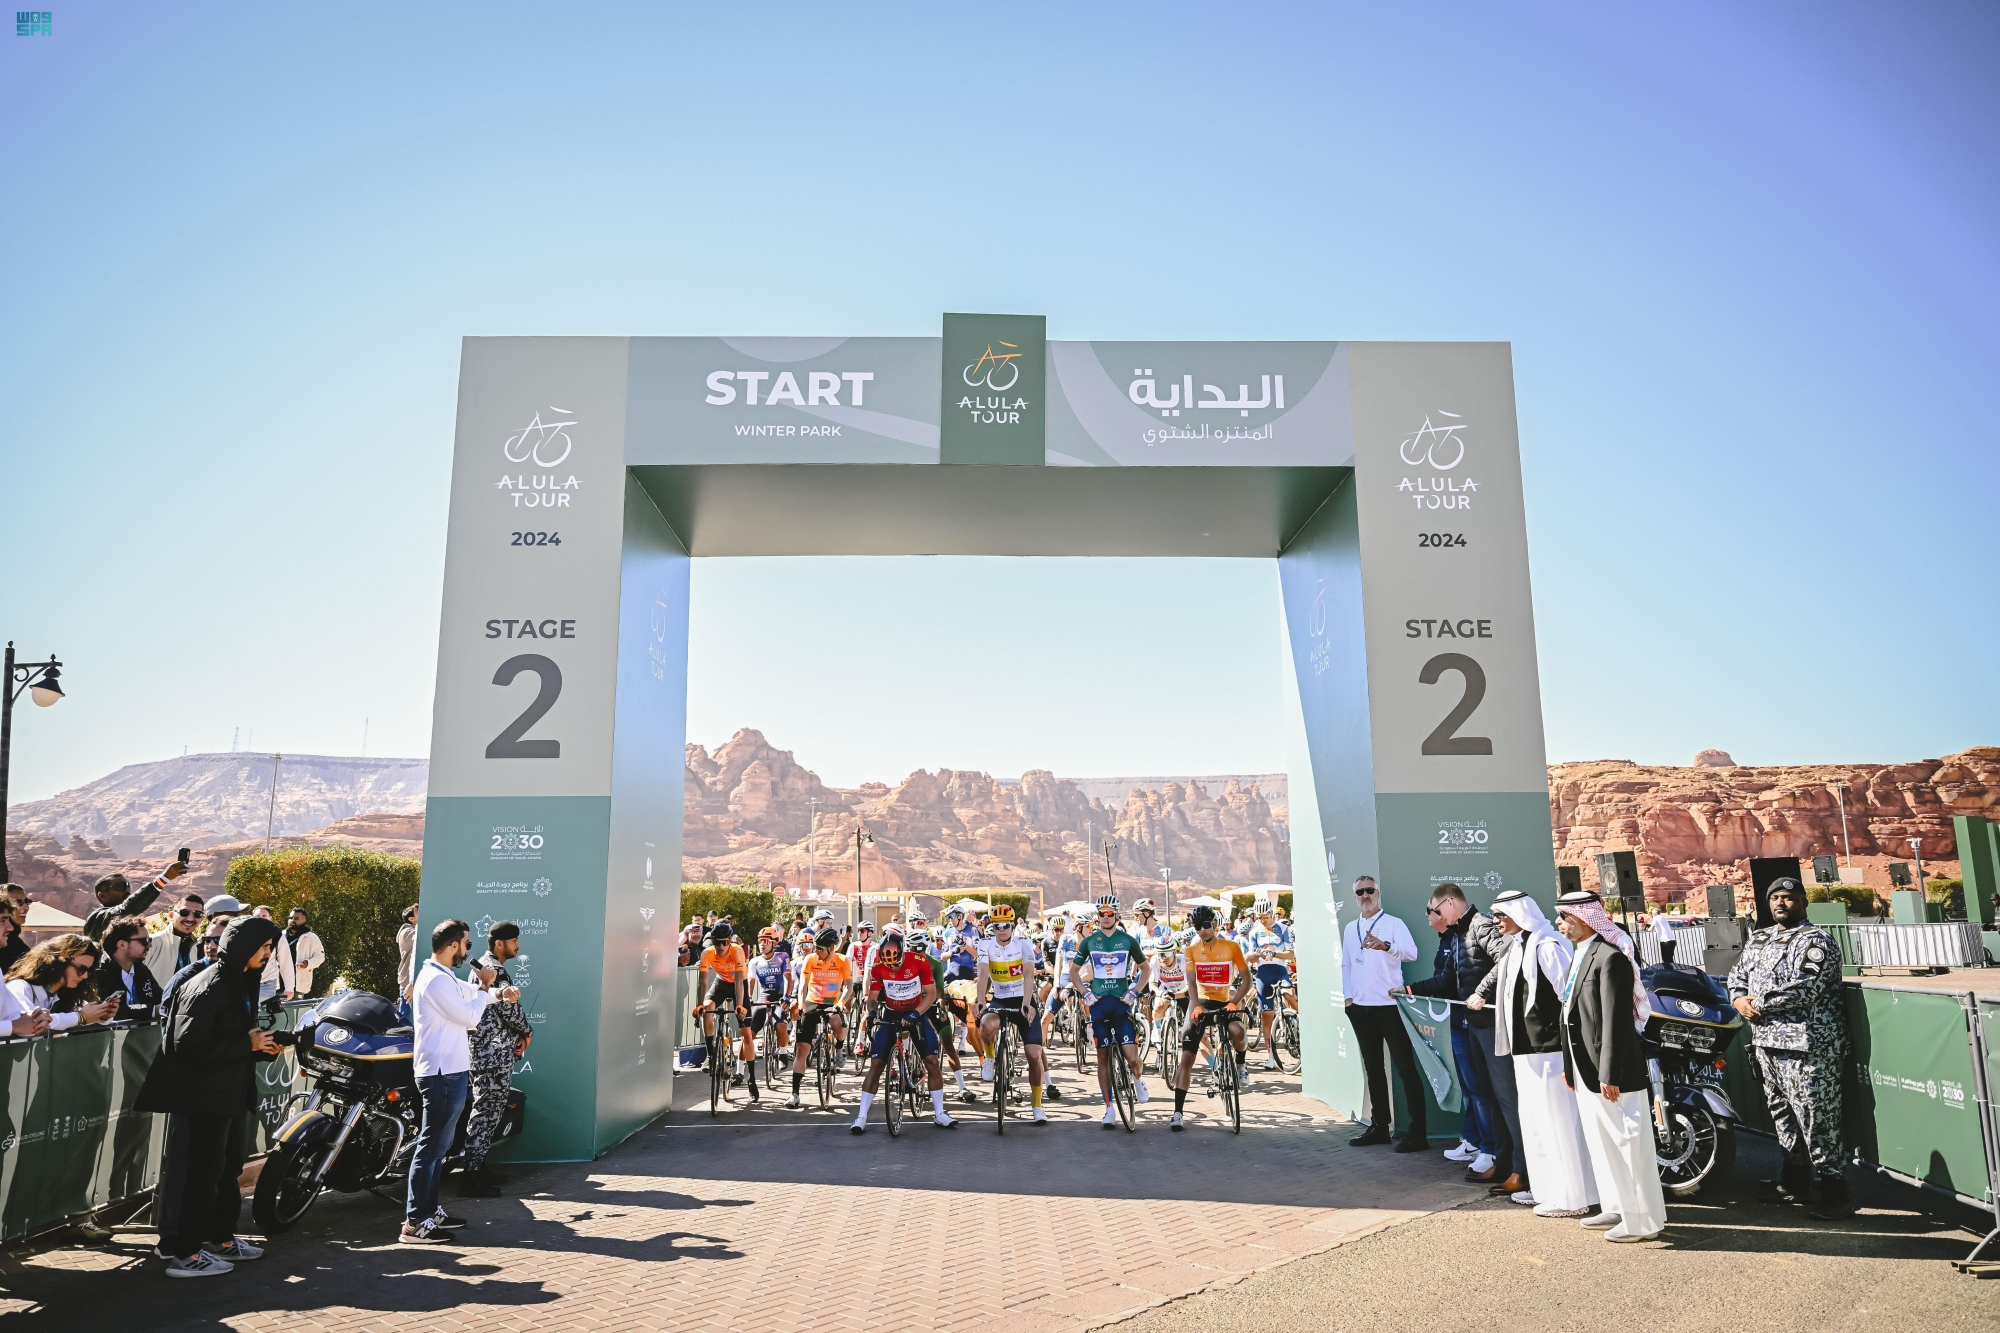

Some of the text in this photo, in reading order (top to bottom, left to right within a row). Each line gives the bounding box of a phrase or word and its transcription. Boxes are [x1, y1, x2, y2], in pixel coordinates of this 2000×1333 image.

[705, 370, 874, 406] START
[1128, 368, 1285, 417] البداية
[957, 396, 1029, 410] ALULA
[971, 410, 1020, 424] TOUR
[735, 425, 842, 437] WINTER PARK
[1142, 423, 1273, 447] المنتزه الشتوي
[494, 474, 584, 490] ALULA
[1394, 476, 1482, 492] ALULA
[511, 492, 571, 508] TOUR
[1412, 494, 1471, 510] TOUR
[511, 531, 562, 547] 2024
[1418, 533, 1468, 548] 2024
[485, 619, 577, 639] STAGE
[1405, 618, 1493, 639] STAGE
[648, 642, 667, 667] ALULA
[1310, 638, 1331, 664] ALULA
[485, 653, 563, 760] 2
[1418, 652, 1494, 756] 2
[490, 834, 544, 850] 2030
[1438, 829, 1489, 844] 2030
[266, 1107, 296, 1125] TOR
